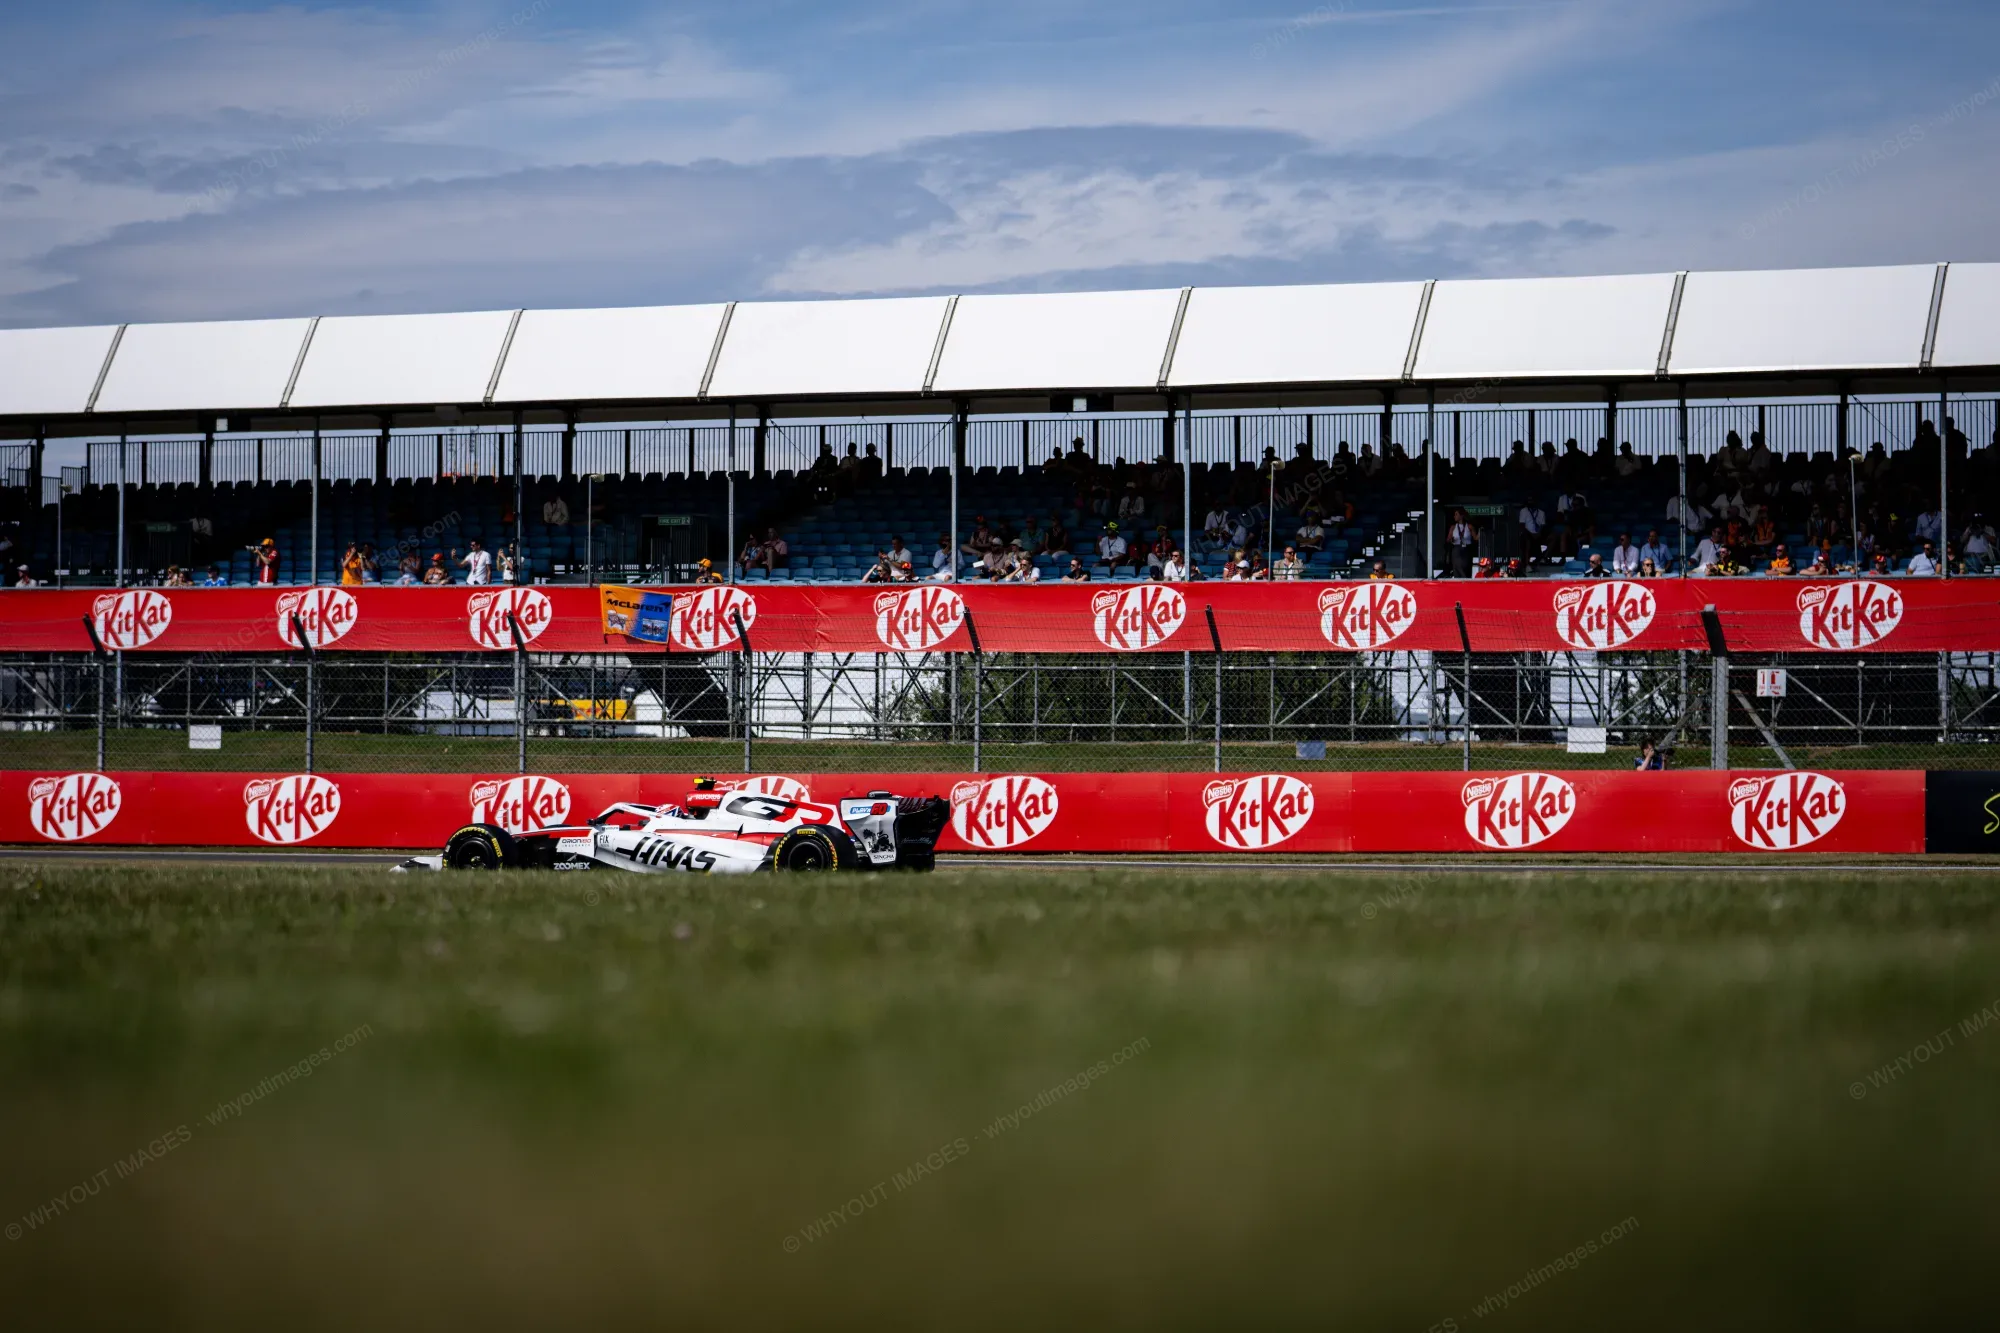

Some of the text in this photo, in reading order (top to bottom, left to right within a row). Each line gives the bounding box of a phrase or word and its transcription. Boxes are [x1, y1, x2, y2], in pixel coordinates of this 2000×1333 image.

[104, 592, 168, 647] KitKat
[288, 589, 353, 646] KitKat
[480, 590, 547, 647] KitKat
[607, 599, 663, 612] McLaren
[681, 588, 752, 647] KitKat
[887, 588, 961, 648] KitKat
[1106, 586, 1181, 648] KitKat
[1333, 585, 1411, 647] KitKat
[1569, 583, 1651, 647] KitKat
[1812, 583, 1897, 648] KitKat
[42, 775, 116, 839] KitKat
[257, 777, 335, 842] KitKat
[485, 778, 566, 832] KitKat
[967, 779, 1052, 845] KitKat
[1220, 778, 1308, 845] KitKat
[1479, 776, 1569, 845] KitKat
[1745, 775, 1840, 847] KitKat
[553, 862, 590, 870] ZOOMEX
[616, 837, 731, 872] HAAS
